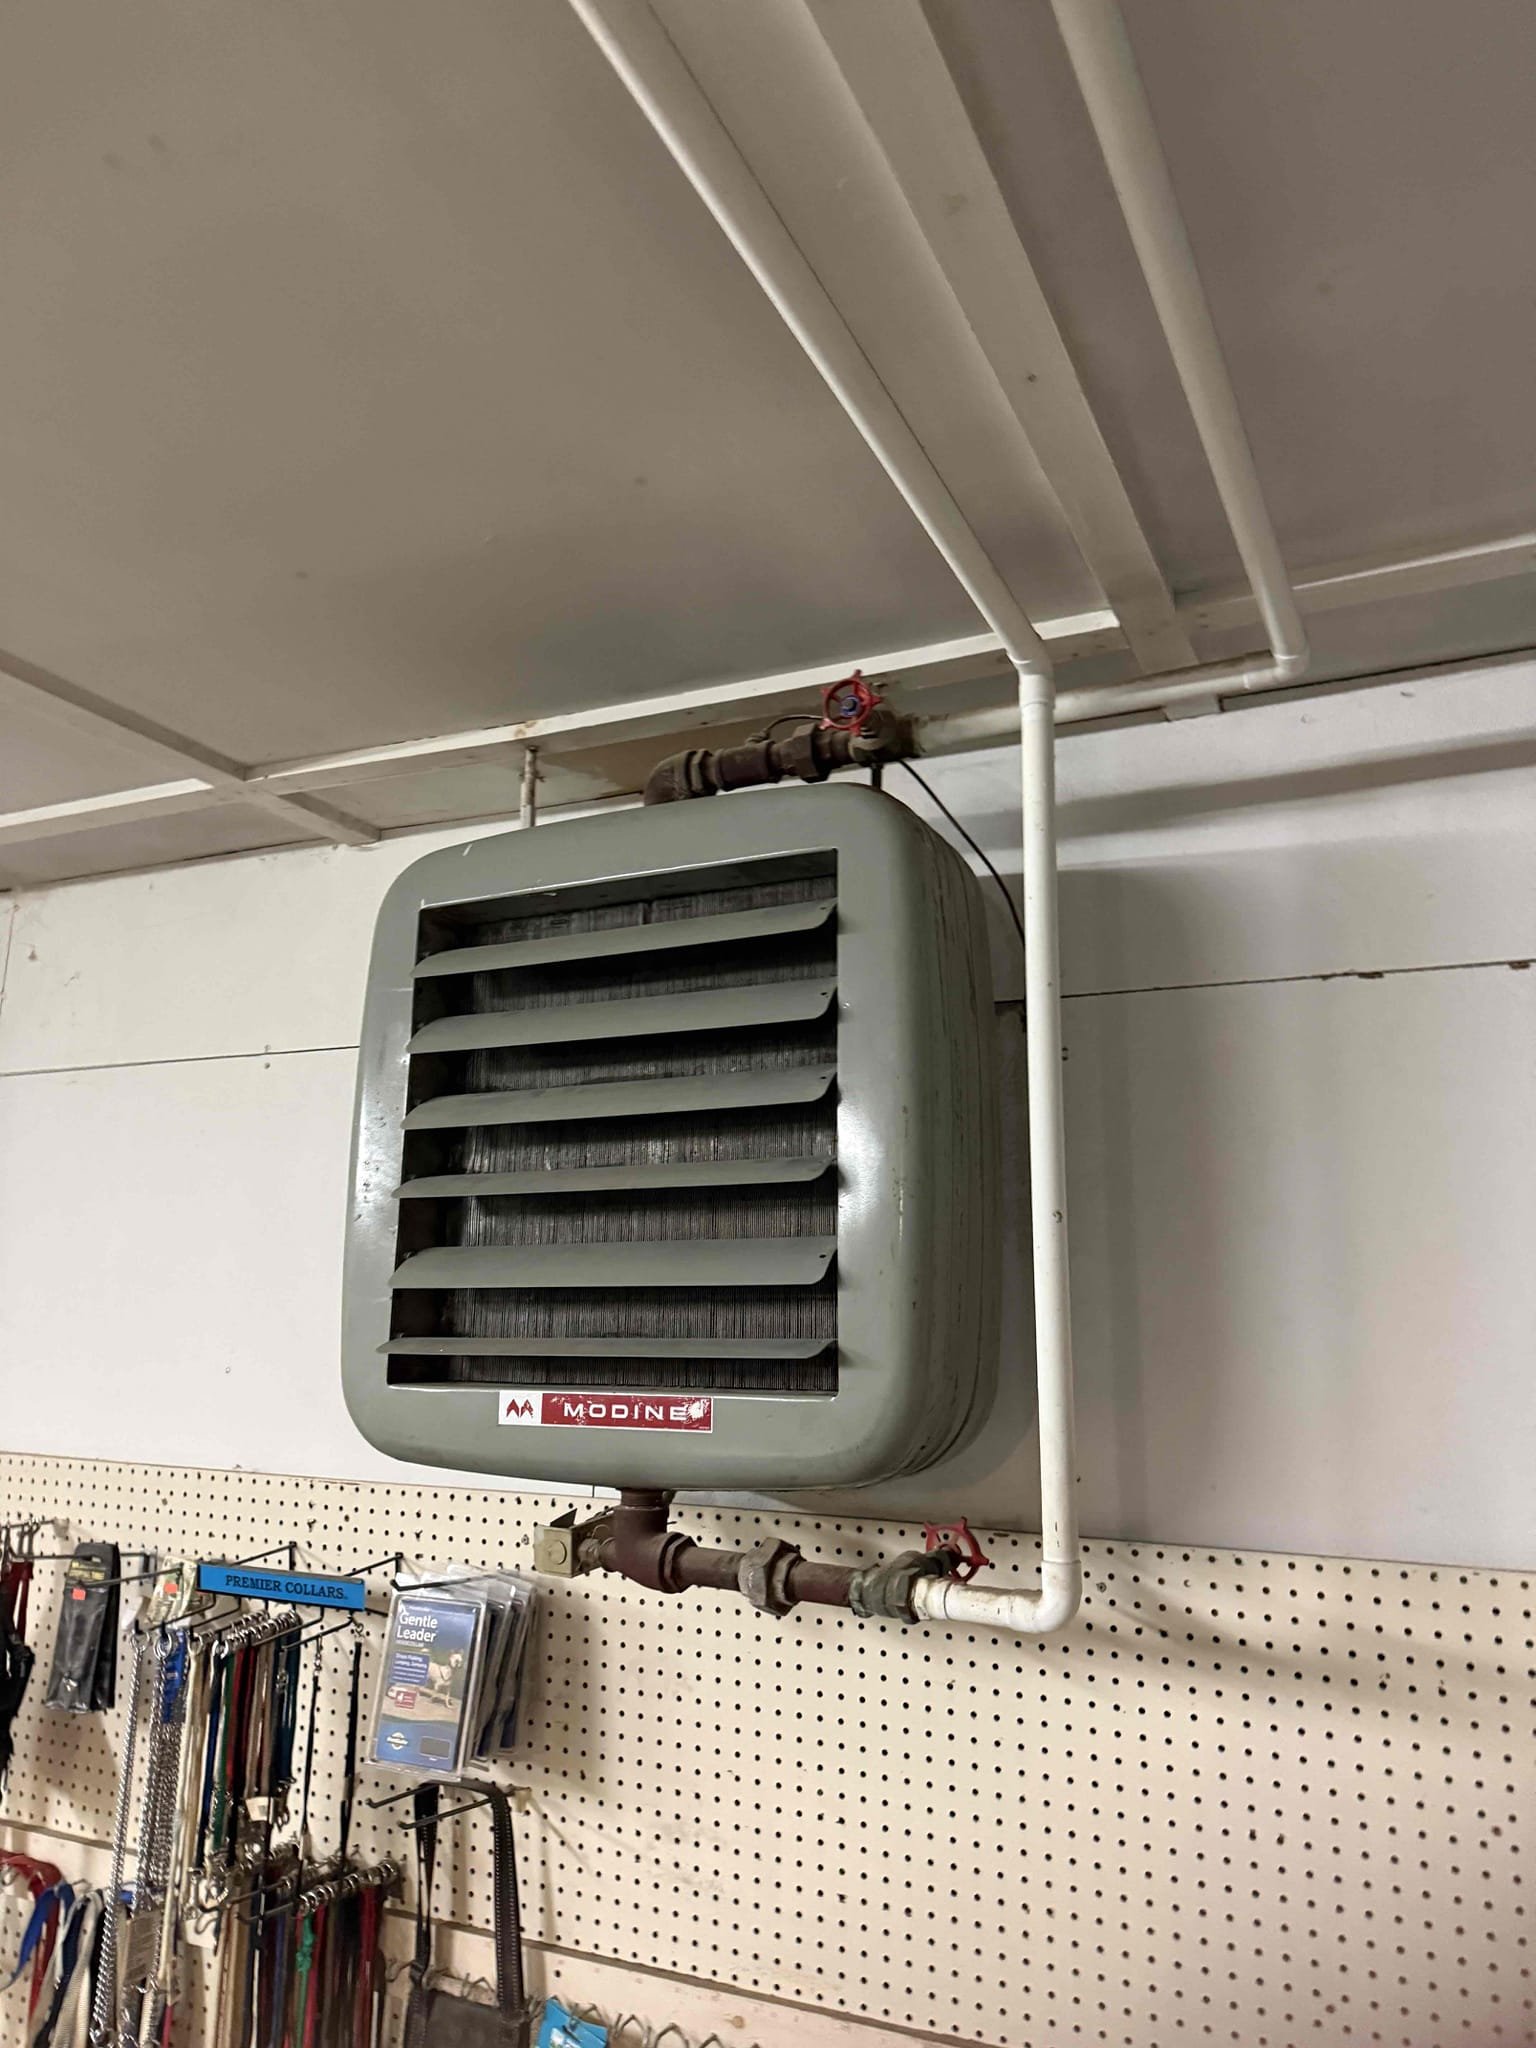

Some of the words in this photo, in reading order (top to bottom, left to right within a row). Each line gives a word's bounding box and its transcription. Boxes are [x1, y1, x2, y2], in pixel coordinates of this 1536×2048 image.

[564, 1402, 687, 1421] MODINE
[225, 1575, 281, 1593] PREMIER
[399, 1612, 438, 1629] Gentle
[396, 1626, 437, 1642] Leader
